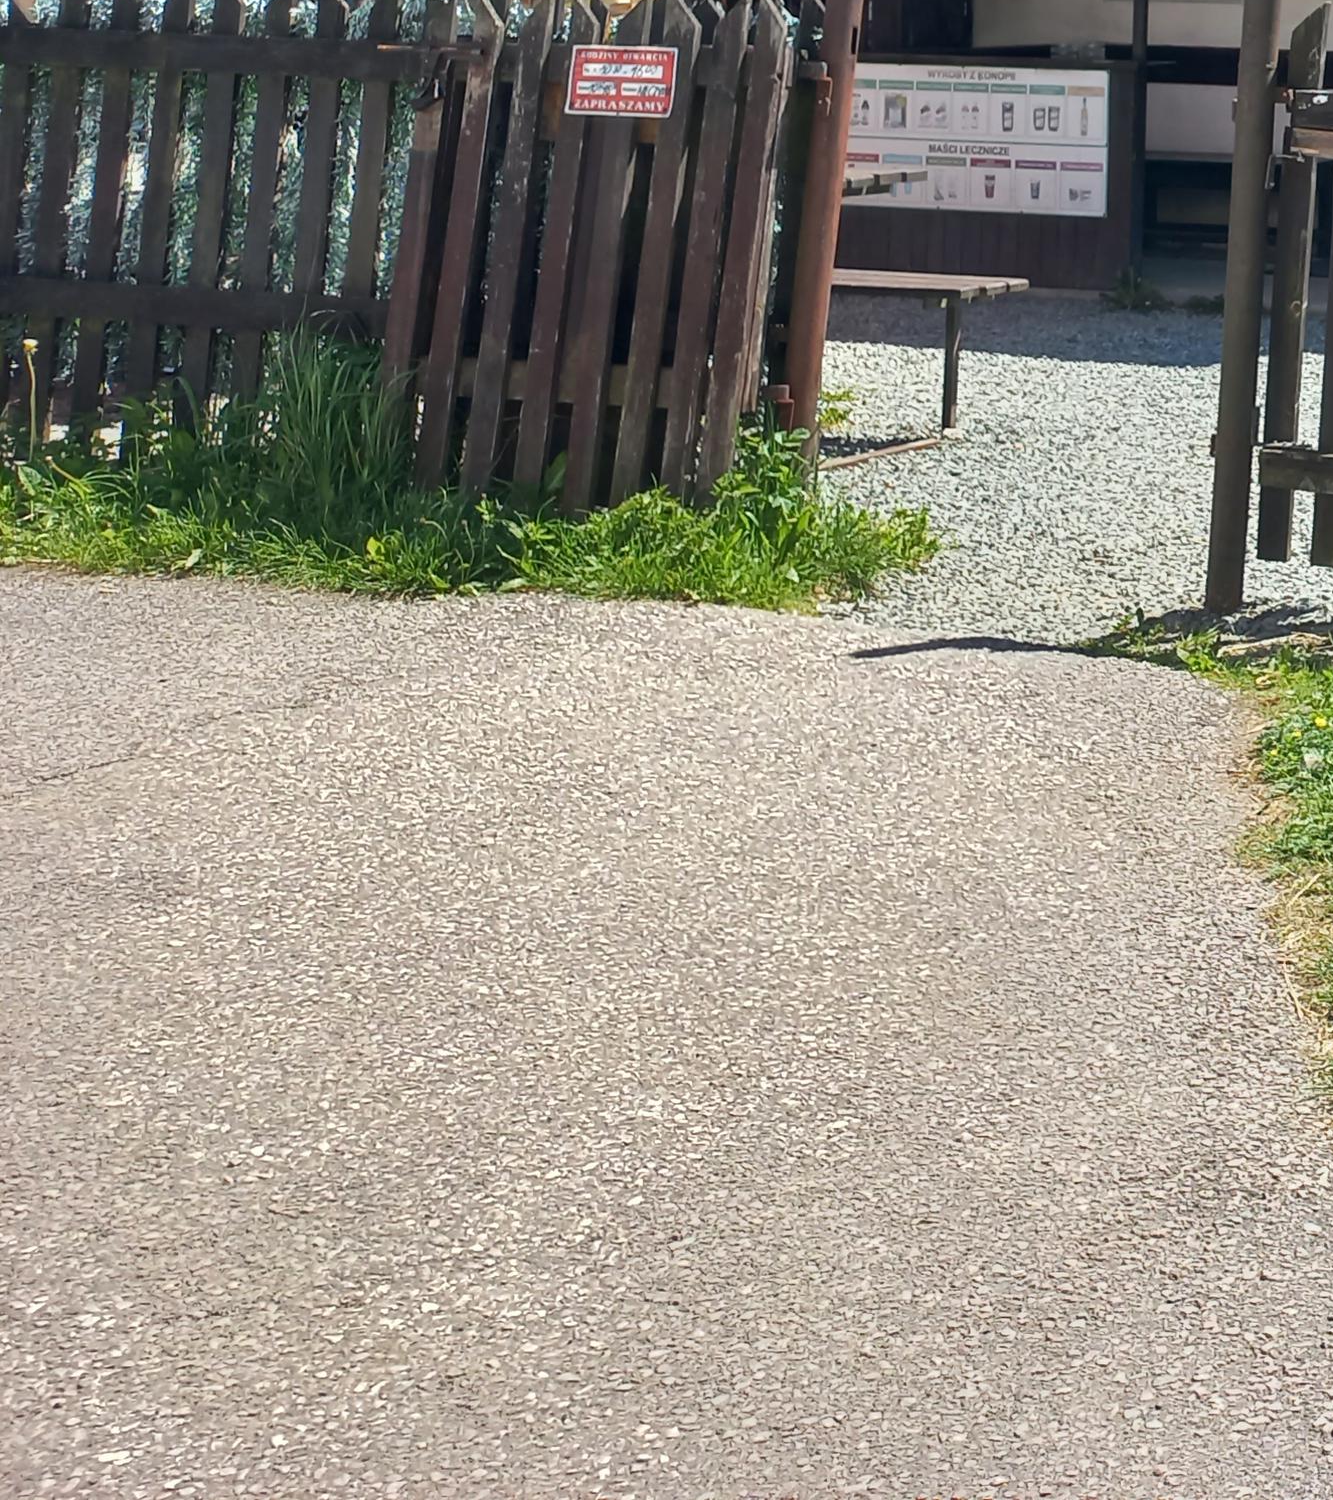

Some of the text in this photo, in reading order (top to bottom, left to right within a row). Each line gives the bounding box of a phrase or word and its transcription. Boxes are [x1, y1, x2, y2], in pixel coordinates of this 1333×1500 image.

[574, 98, 665, 112] ZAPRASZAMY
[928, 142, 1010, 156] MAŚCI LECZNICZE
